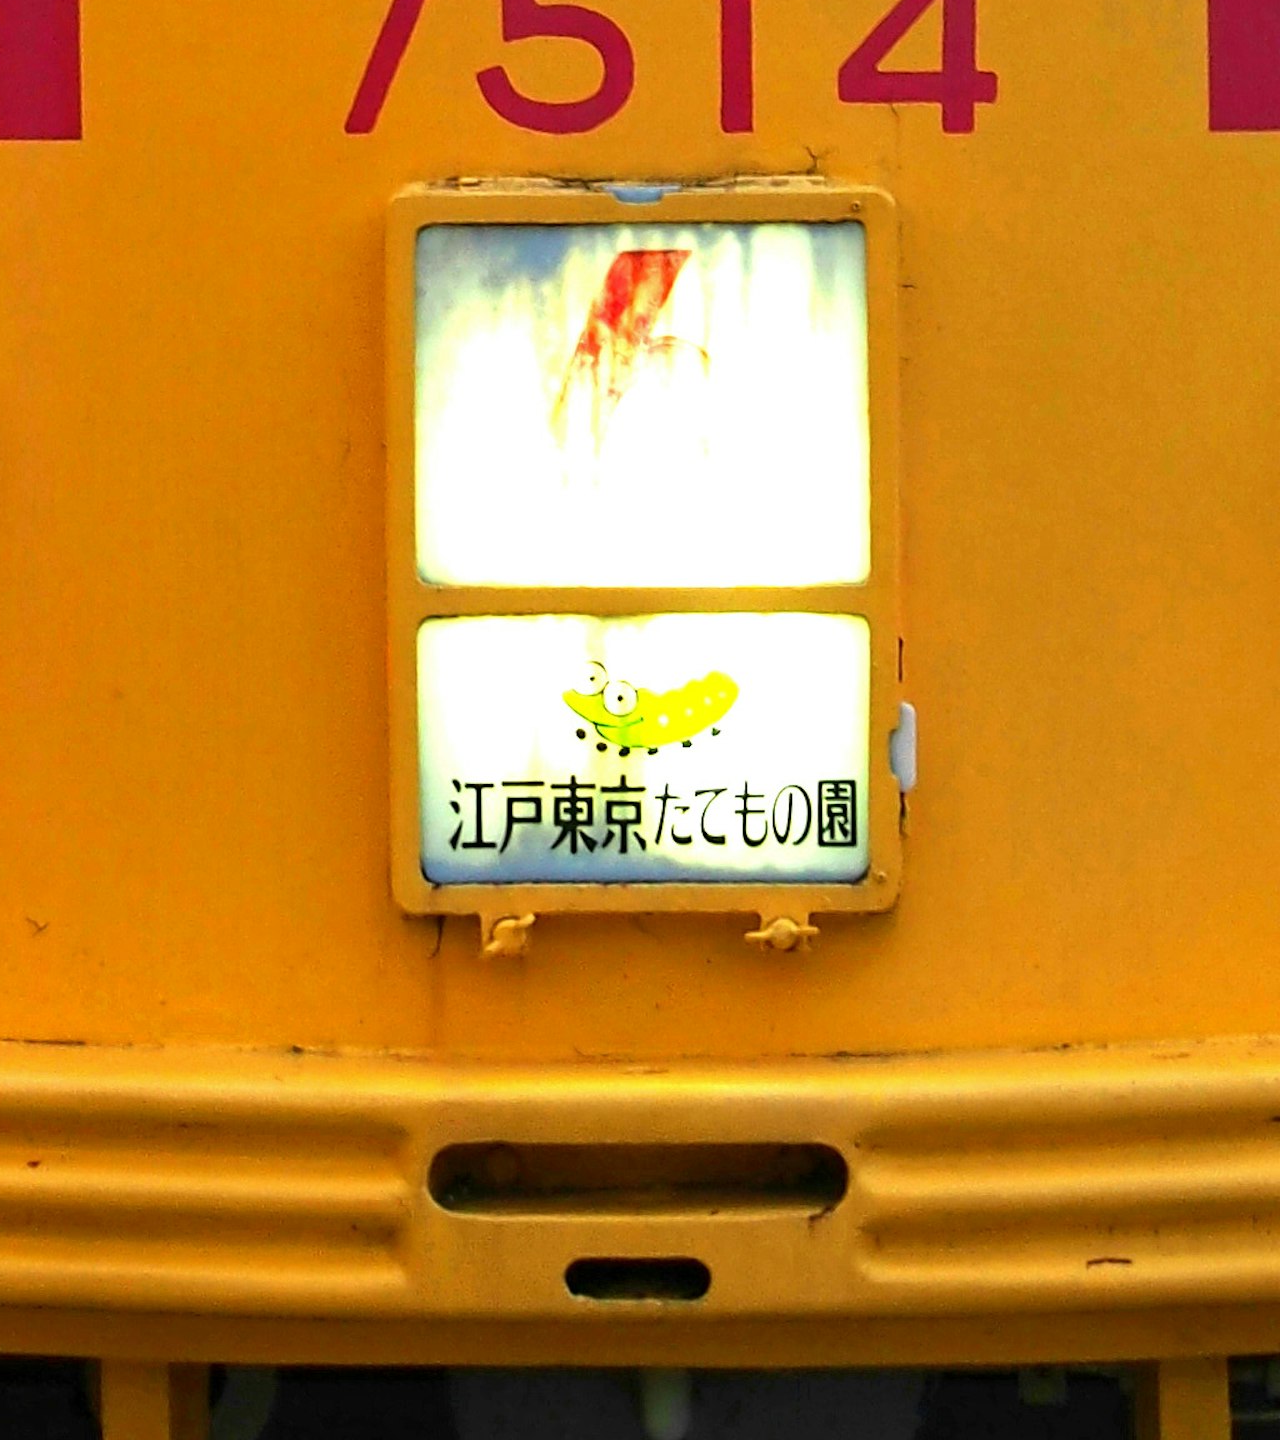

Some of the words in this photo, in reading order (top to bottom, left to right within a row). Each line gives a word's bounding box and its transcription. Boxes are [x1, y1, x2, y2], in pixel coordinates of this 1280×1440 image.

[450, 775, 857, 855] 江戸東京たてもの園
